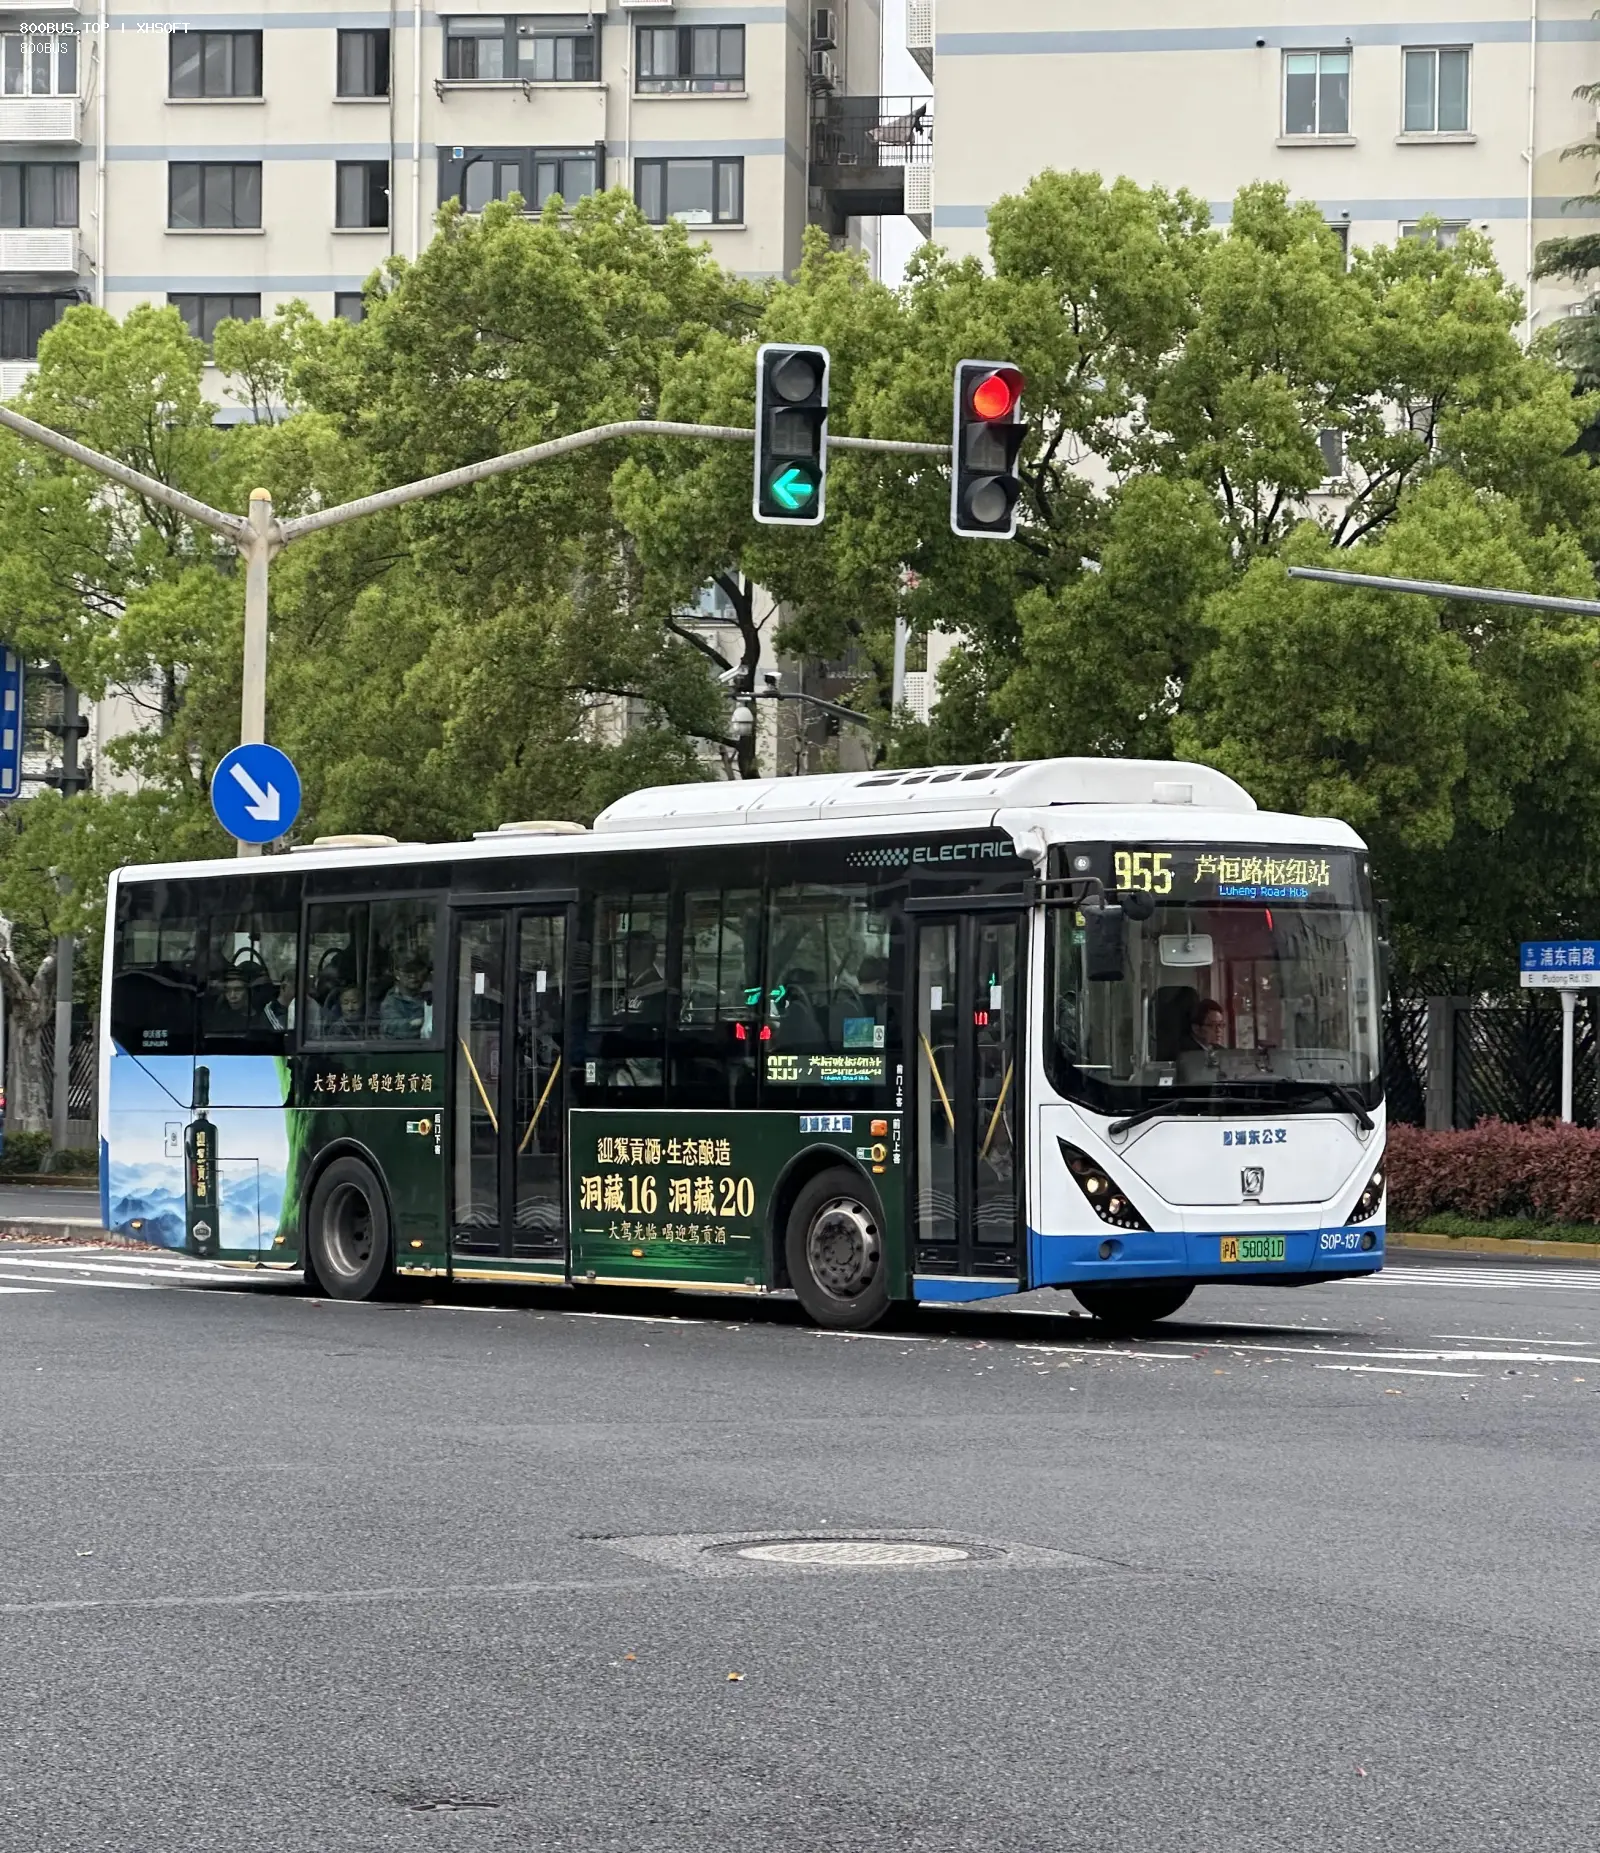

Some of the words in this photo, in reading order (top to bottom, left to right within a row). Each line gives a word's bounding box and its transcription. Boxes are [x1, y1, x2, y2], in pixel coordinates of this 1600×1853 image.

[912, 841, 1013, 863] ELECTRIC
[1114, 851, 1172, 894] 955
[1194, 854, 1331, 886] 芦恒路枢纽站
[1219, 885, 1257, 898] Luheng
[1261, 886, 1286, 897] Road
[1289, 887, 1309, 898] Hub
[1541, 946, 1596, 967] 浦东南路
[314, 1073, 363, 1094] 大驾光临
[368, 1072, 432, 1093] 喝迎驾贡酒
[1235, 1128, 1287, 1146] 浦东公交
[580, 1173, 658, 1214] 洞藏16
[669, 1175, 755, 1218] 洞藏20
[608, 1220, 658, 1241] 大驾光临
[661, 1222, 726, 1245] 喝迎驾贡酒
